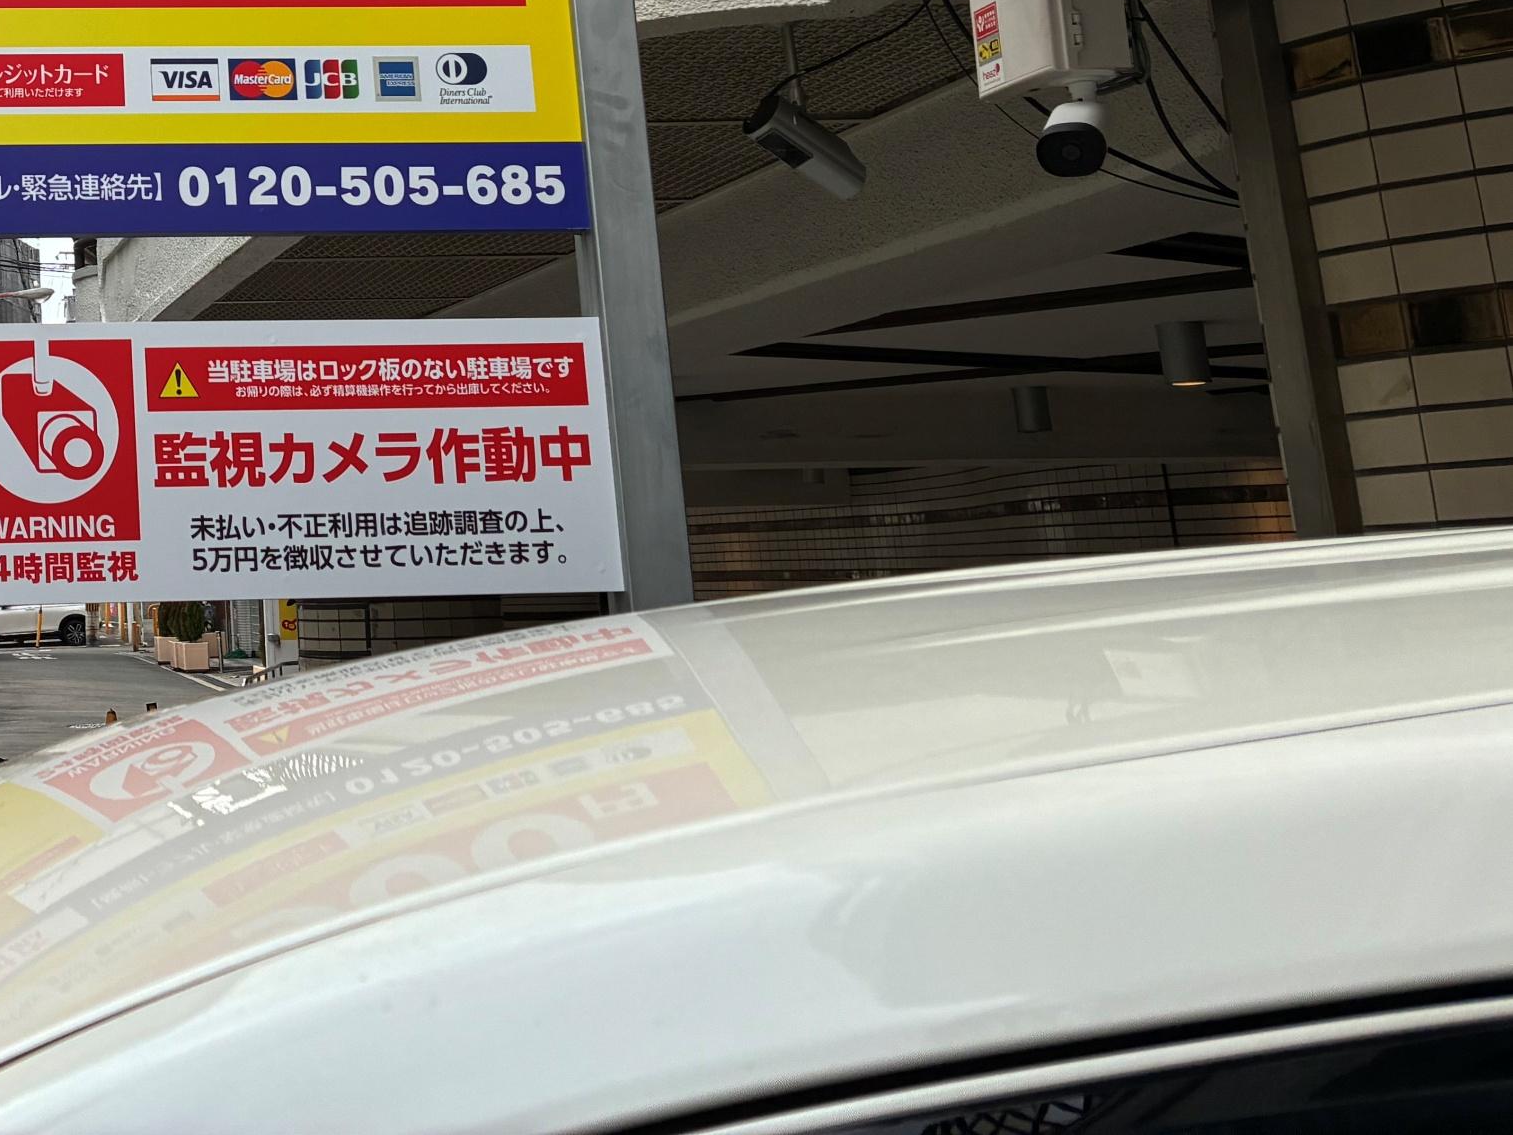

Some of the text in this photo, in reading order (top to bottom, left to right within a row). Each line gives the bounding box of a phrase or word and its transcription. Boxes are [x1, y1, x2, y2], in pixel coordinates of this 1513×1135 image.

[158, 70, 213, 89] VISA
[234, 72, 292, 85] MasterCard
[304, 72, 357, 86] JCB
[439, 87, 486, 97] Diners Club
[178, 164, 566, 206] 0120-505-685
[207, 356, 574, 385] 当駐車場はロック板のない駐車場です
[154, 426, 592, 488] 監視カメラ作動中
